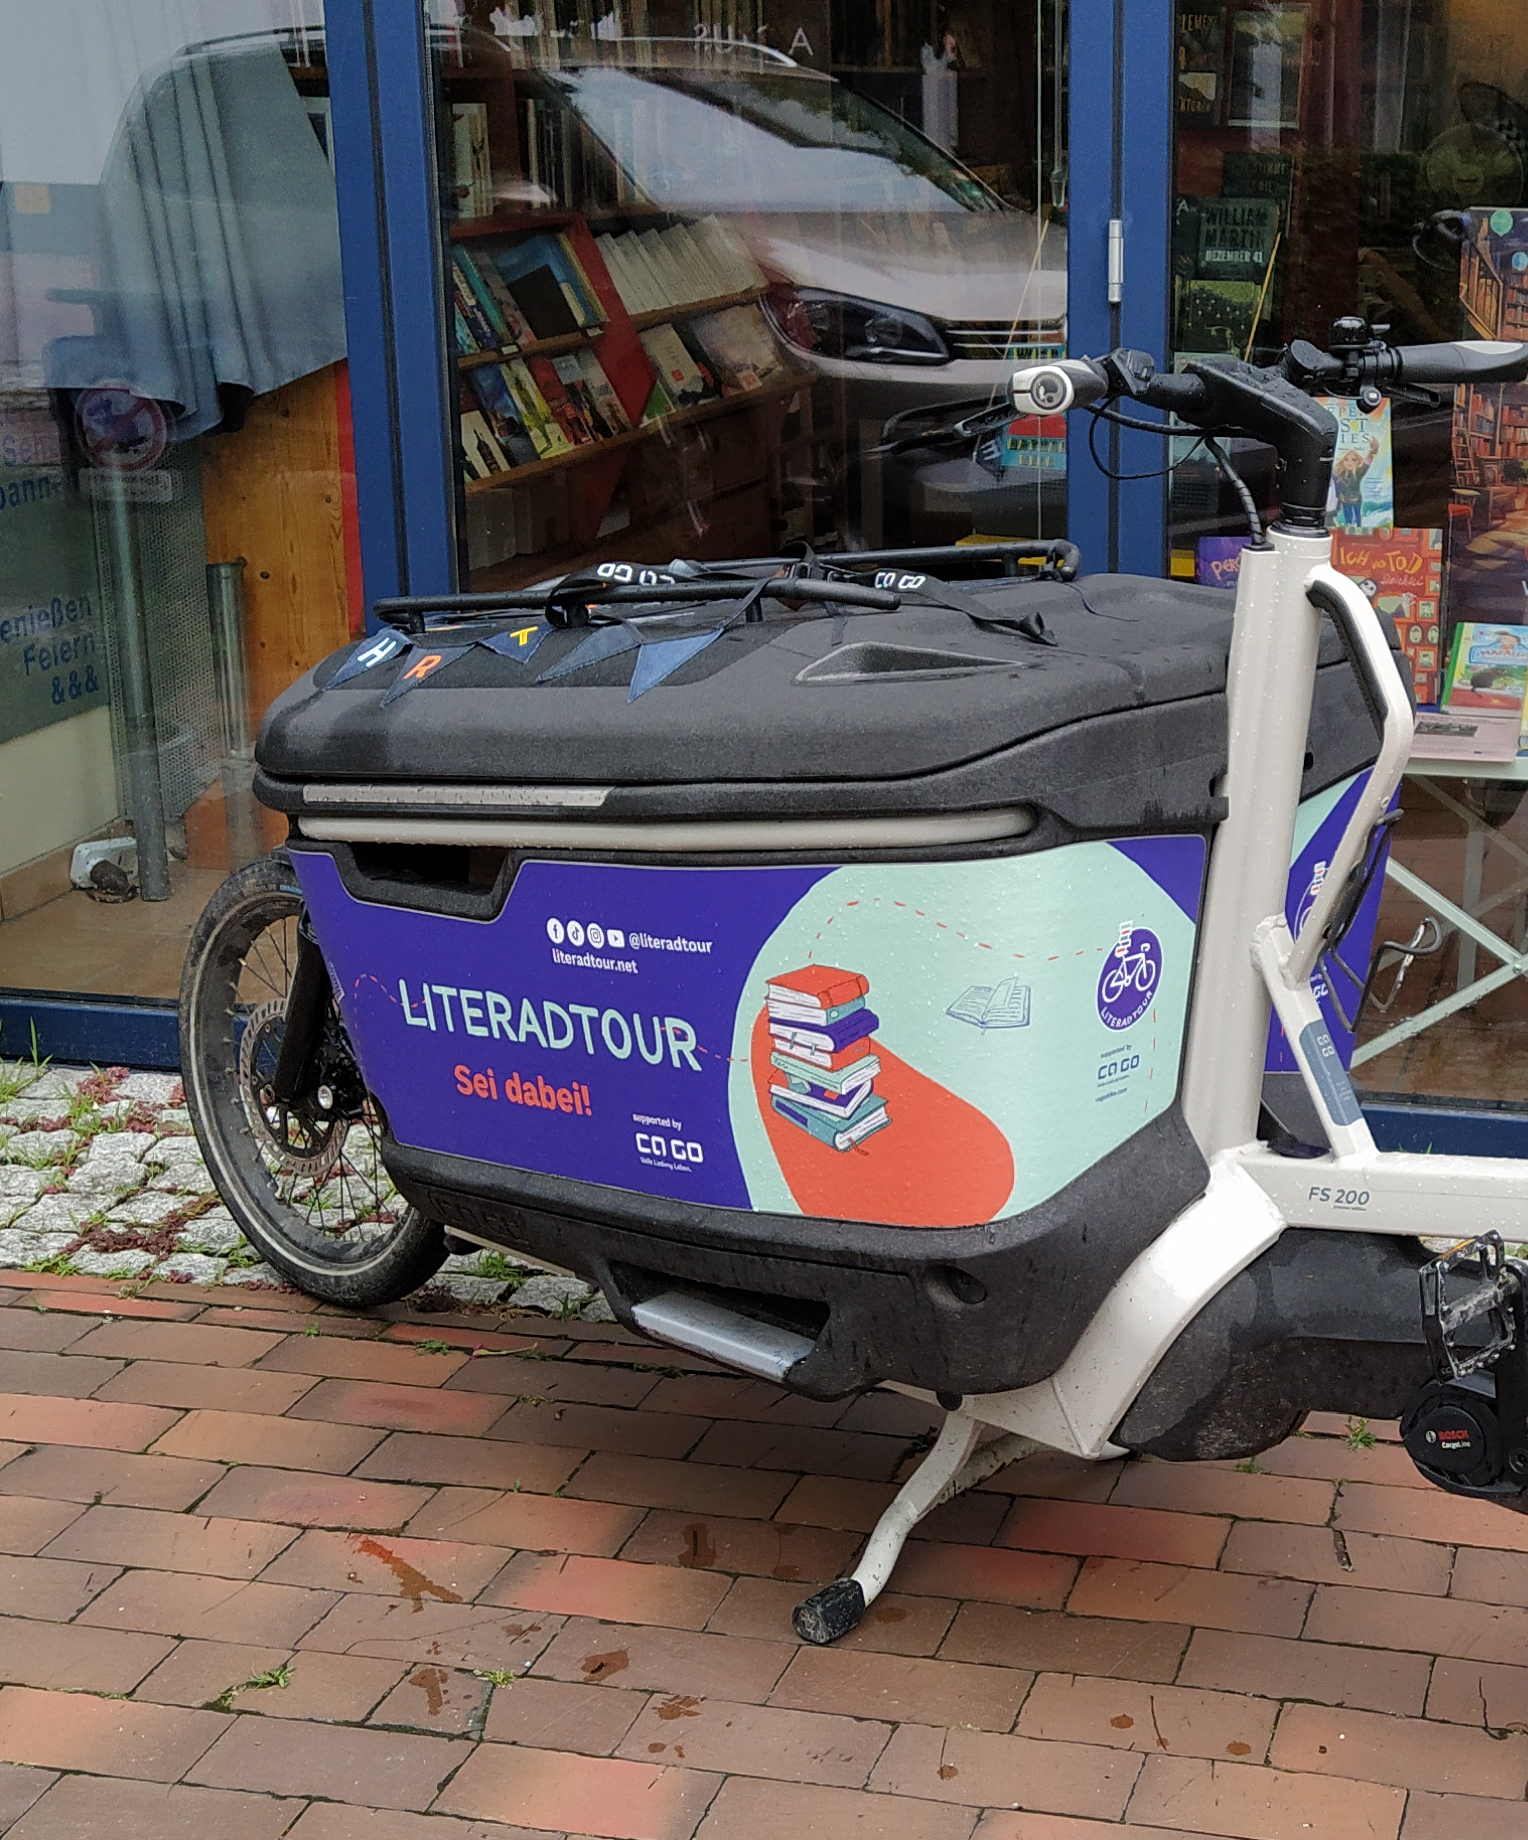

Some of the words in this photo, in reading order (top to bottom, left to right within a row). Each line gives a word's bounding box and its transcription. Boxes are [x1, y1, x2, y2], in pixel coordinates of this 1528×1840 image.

[1205, 206, 1269, 227] WILLIAM
[1204, 228, 1265, 248] MARTIN
[1205, 250, 1251, 263] DEZEMBER
[1252, 250, 1263, 263] 41
[1340, 547, 1371, 566] ICH
[1384, 549, 1423, 574] TOD
[0, 597, 92, 643] enießen
[509, 625, 539, 647] T
[22, 631, 96, 676] Feiern
[357, 637, 397, 668] H
[403, 654, 443, 680] R
[628, 932, 713, 954] @literadtour
[551, 948, 639, 974] literadtour.net
[1101, 990, 1153, 1028] LITERADTOUR
[399, 978, 703, 1072] LITERADTOUR
[454, 1064, 498, 1100] Sei
[505, 1071, 593, 1116] dabei!
[632, 1113, 671, 1128] supported
[671, 1118, 682, 1131] by
[1308, 1186, 1332, 1202] FS
[1334, 1189, 1370, 1206] 200
[1438, 1429, 1469, 1441] BOSCH
